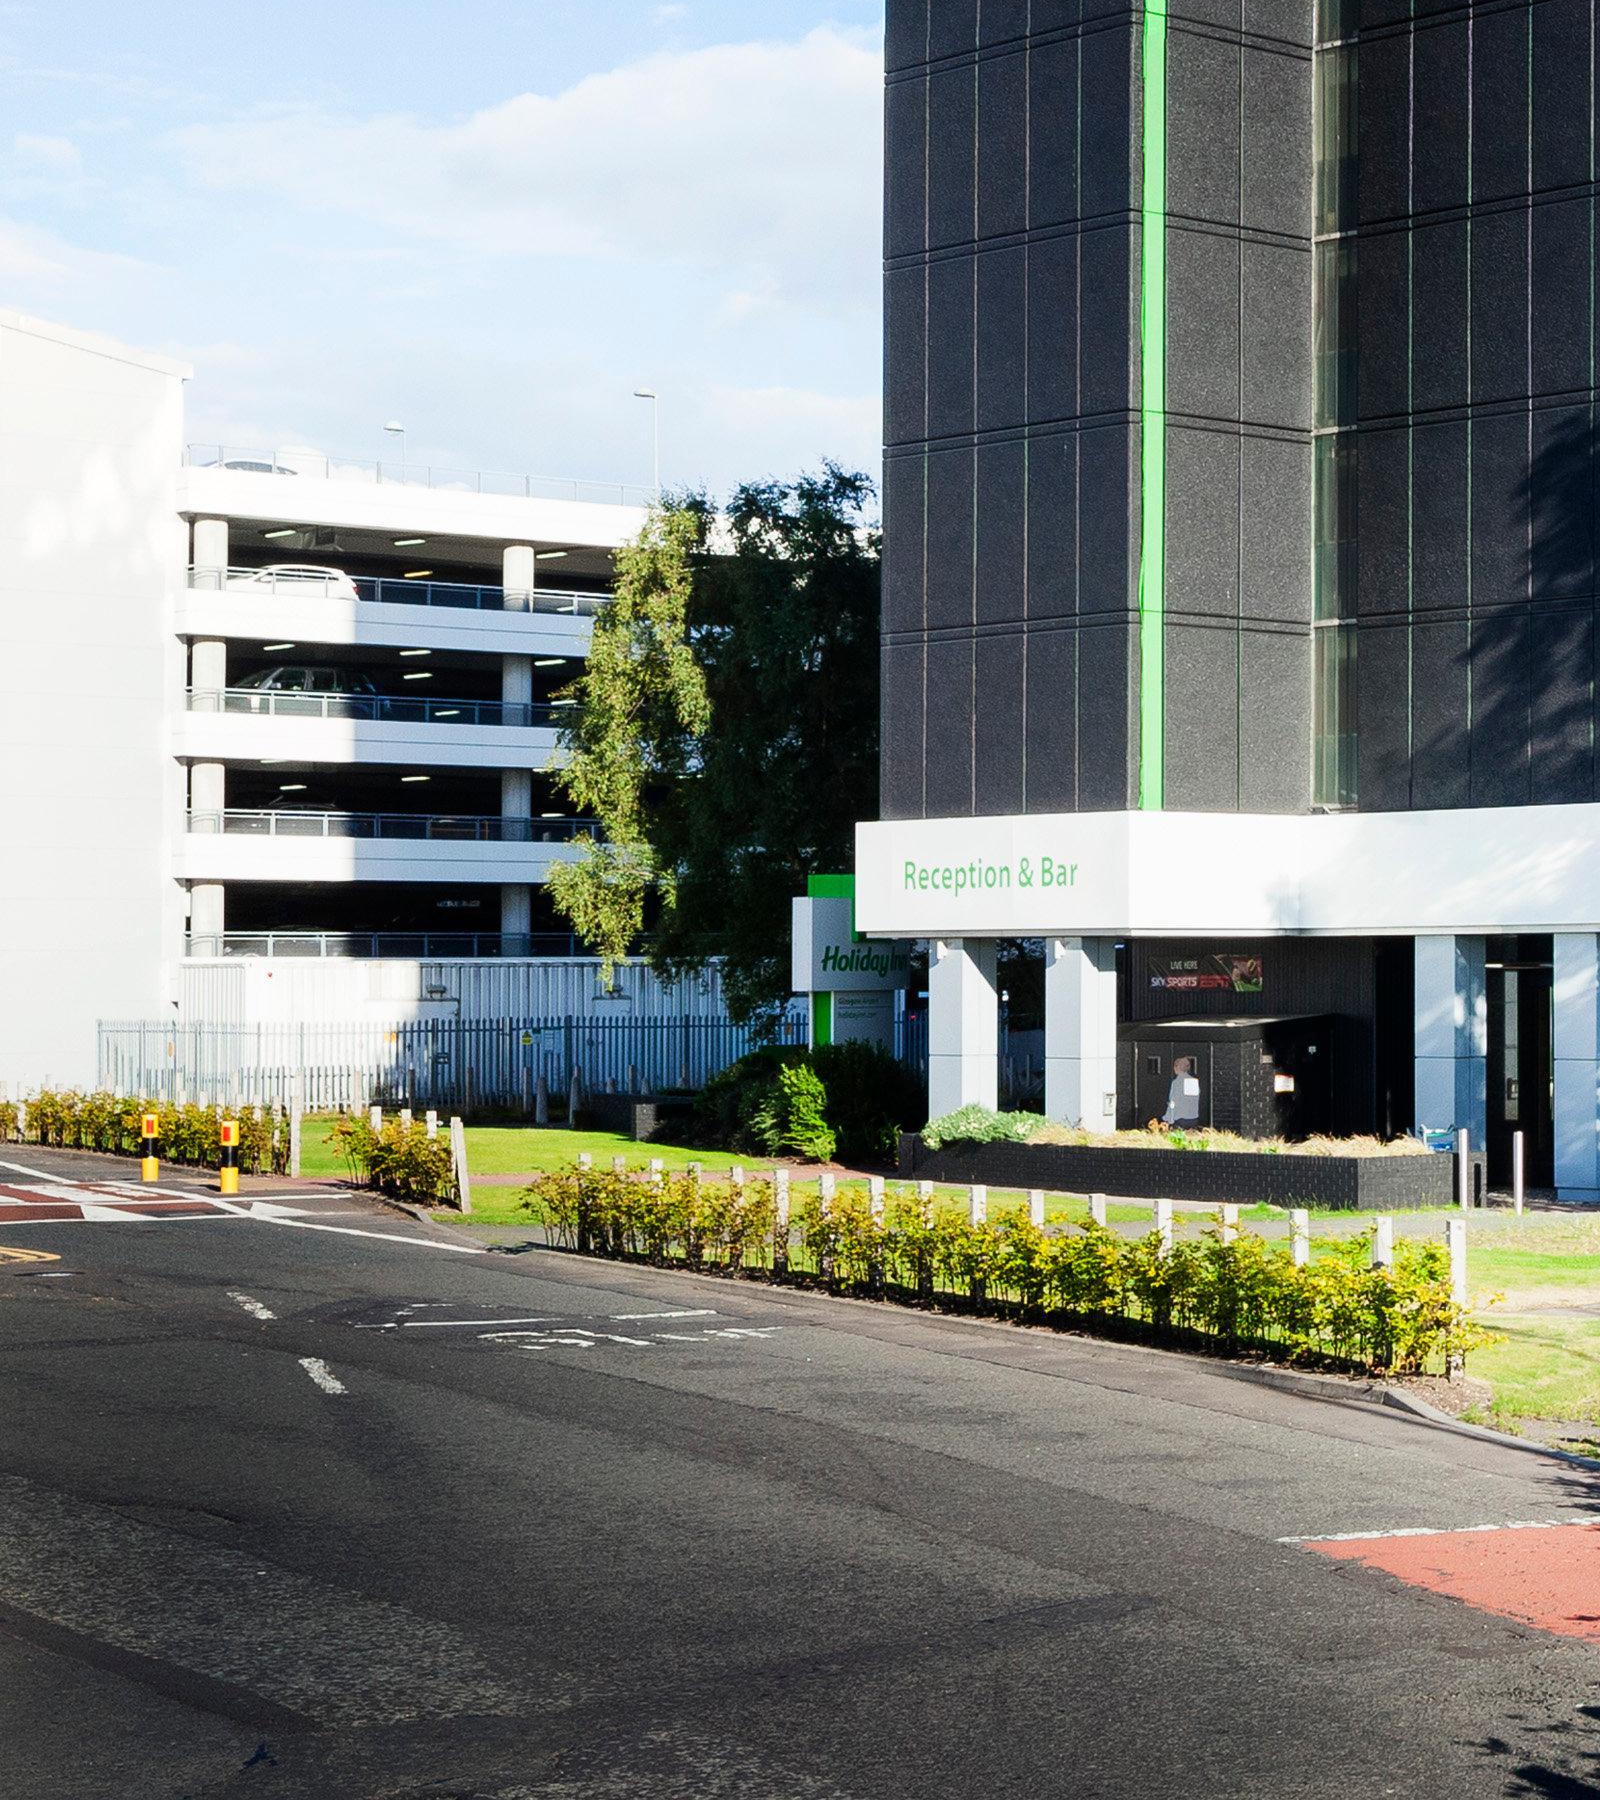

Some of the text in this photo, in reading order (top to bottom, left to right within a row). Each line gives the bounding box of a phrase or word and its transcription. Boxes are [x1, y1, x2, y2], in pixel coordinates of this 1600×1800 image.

[903, 855, 1079, 898] Reception & Bar
[820, 945, 890, 978] Holiday
[1170, 960, 1199, 970] LIVE HERE
[1166, 976, 1198, 988] SPORTS
